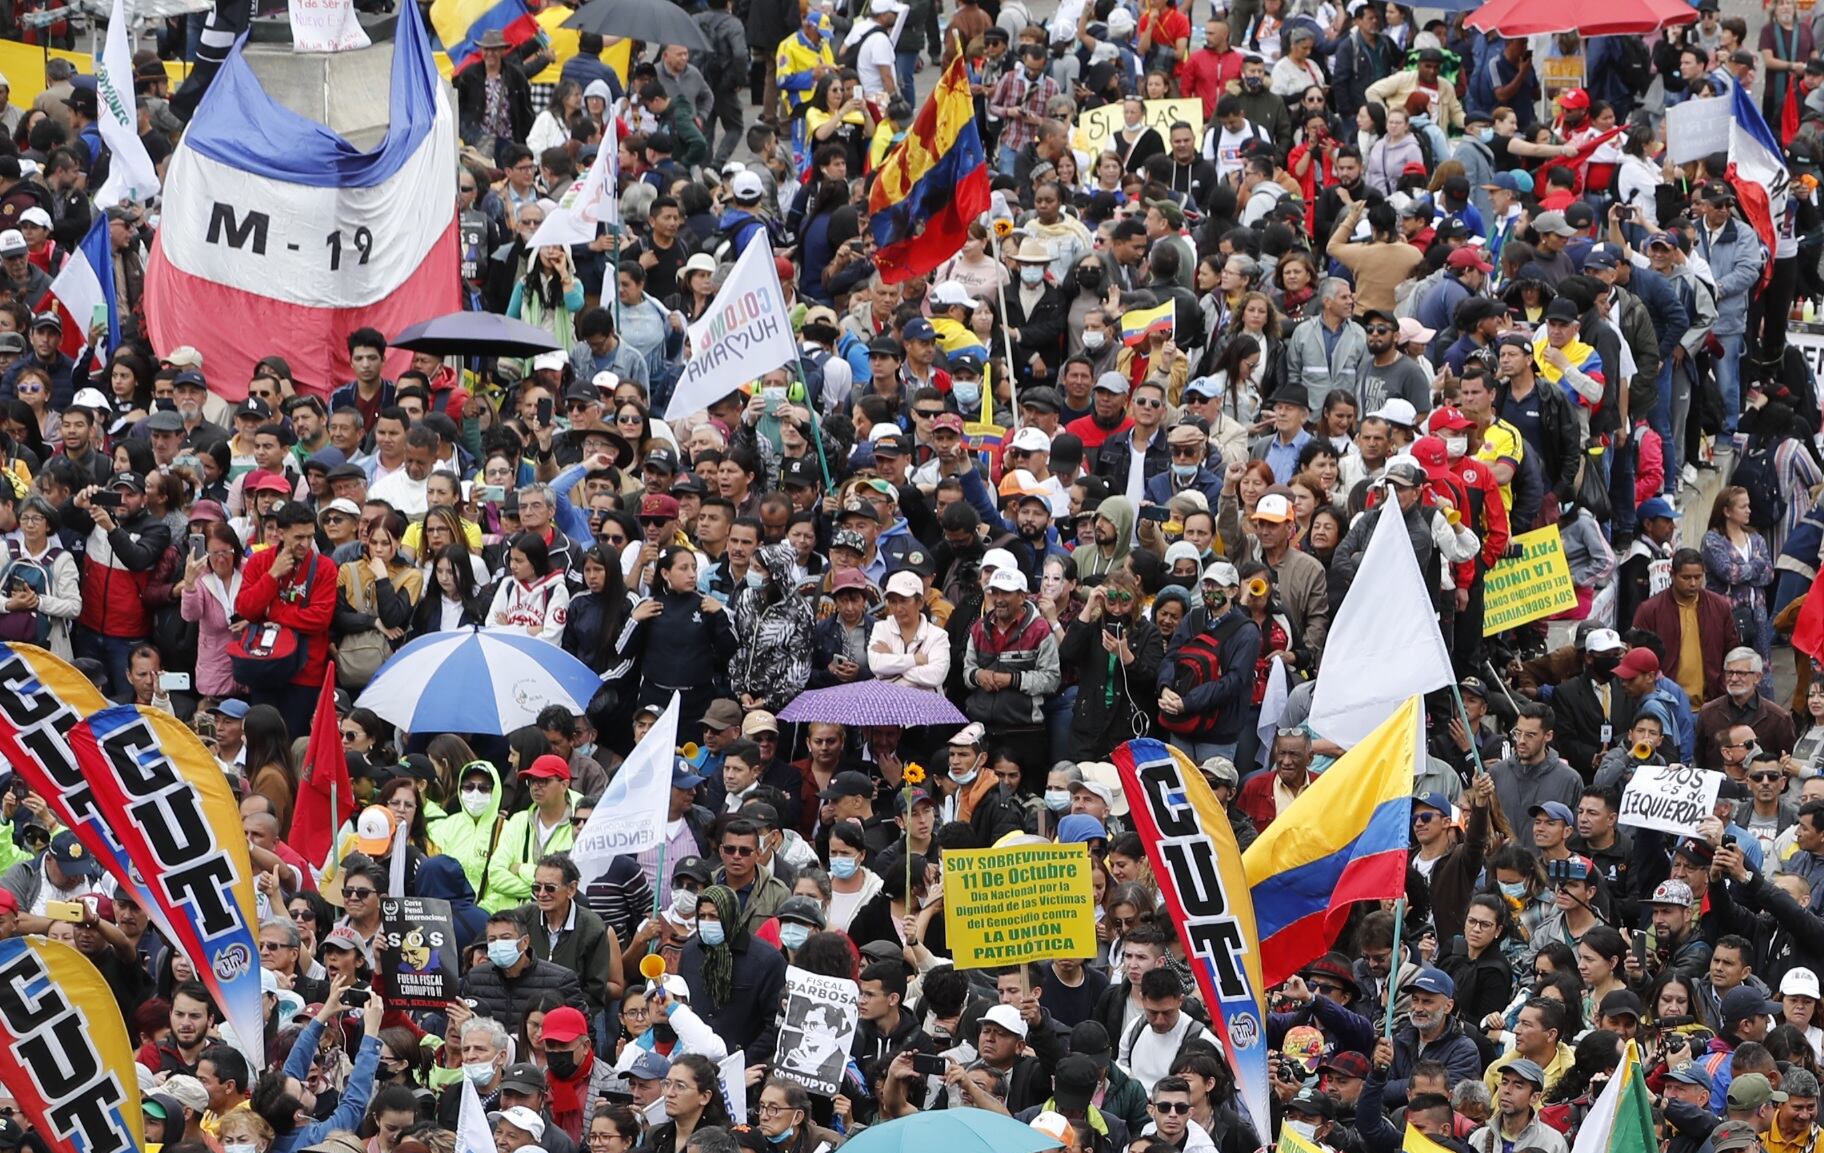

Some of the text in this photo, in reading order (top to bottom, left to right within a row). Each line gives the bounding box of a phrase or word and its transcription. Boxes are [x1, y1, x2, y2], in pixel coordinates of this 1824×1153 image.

[1089, 112, 1110, 140] SI
[206, 201, 270, 256] M
[326, 226, 373, 271] 19
[1653, 767, 1707, 790] DIOS
[1622, 789, 1707, 826] IZQUIERDA
[97, 718, 241, 944] CUT
[947, 856, 974, 872] SOY
[961, 861, 1077, 889] 11 De Octubre
[1139, 759, 1251, 1000] CUT
[990, 884, 1037, 900] Nacional
[1039, 883, 1057, 896] por
[956, 901, 1004, 918] Dignidad
[1006, 899, 1019, 911] de
[1021, 898, 1037, 909] las
[967, 909, 1078, 929] del Genocidio contra
[983, 921, 1062, 944] LA UNIÓN
[974, 936, 1075, 960] PATRIÓTICA
[397, 973, 444, 986] FUERA FISCAL
[806, 976, 844, 992] FISCAL
[787, 979, 858, 1006] BARBOSA
